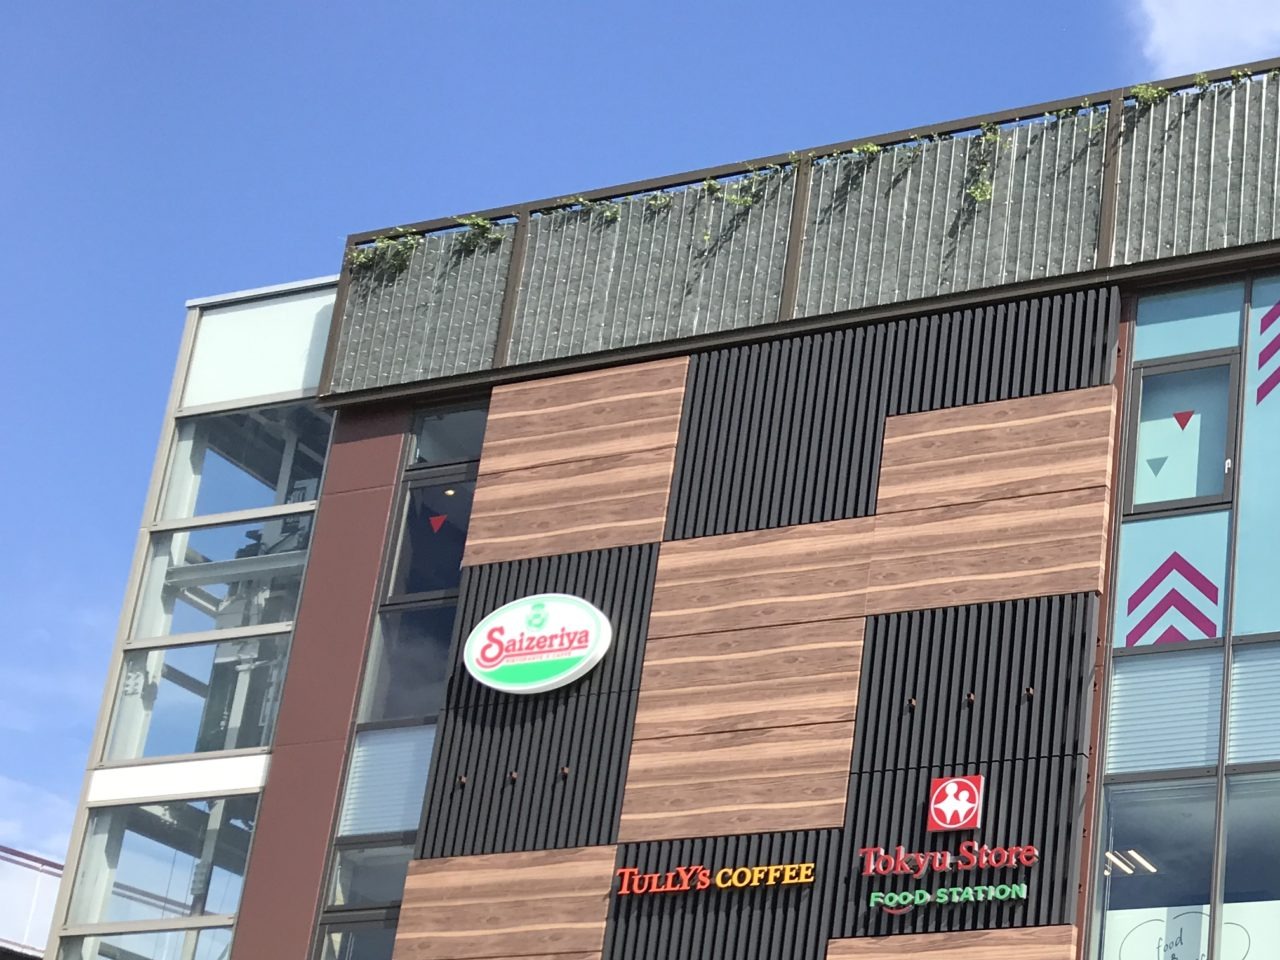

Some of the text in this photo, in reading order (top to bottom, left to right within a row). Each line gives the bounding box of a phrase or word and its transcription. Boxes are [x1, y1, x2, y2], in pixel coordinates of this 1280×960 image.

[480, 626, 590, 663] Saizeriya
[859, 840, 1040, 880] Tokyu Store
[715, 863, 815, 889] COFFEE
[869, 883, 1028, 907] FOOD STATION
